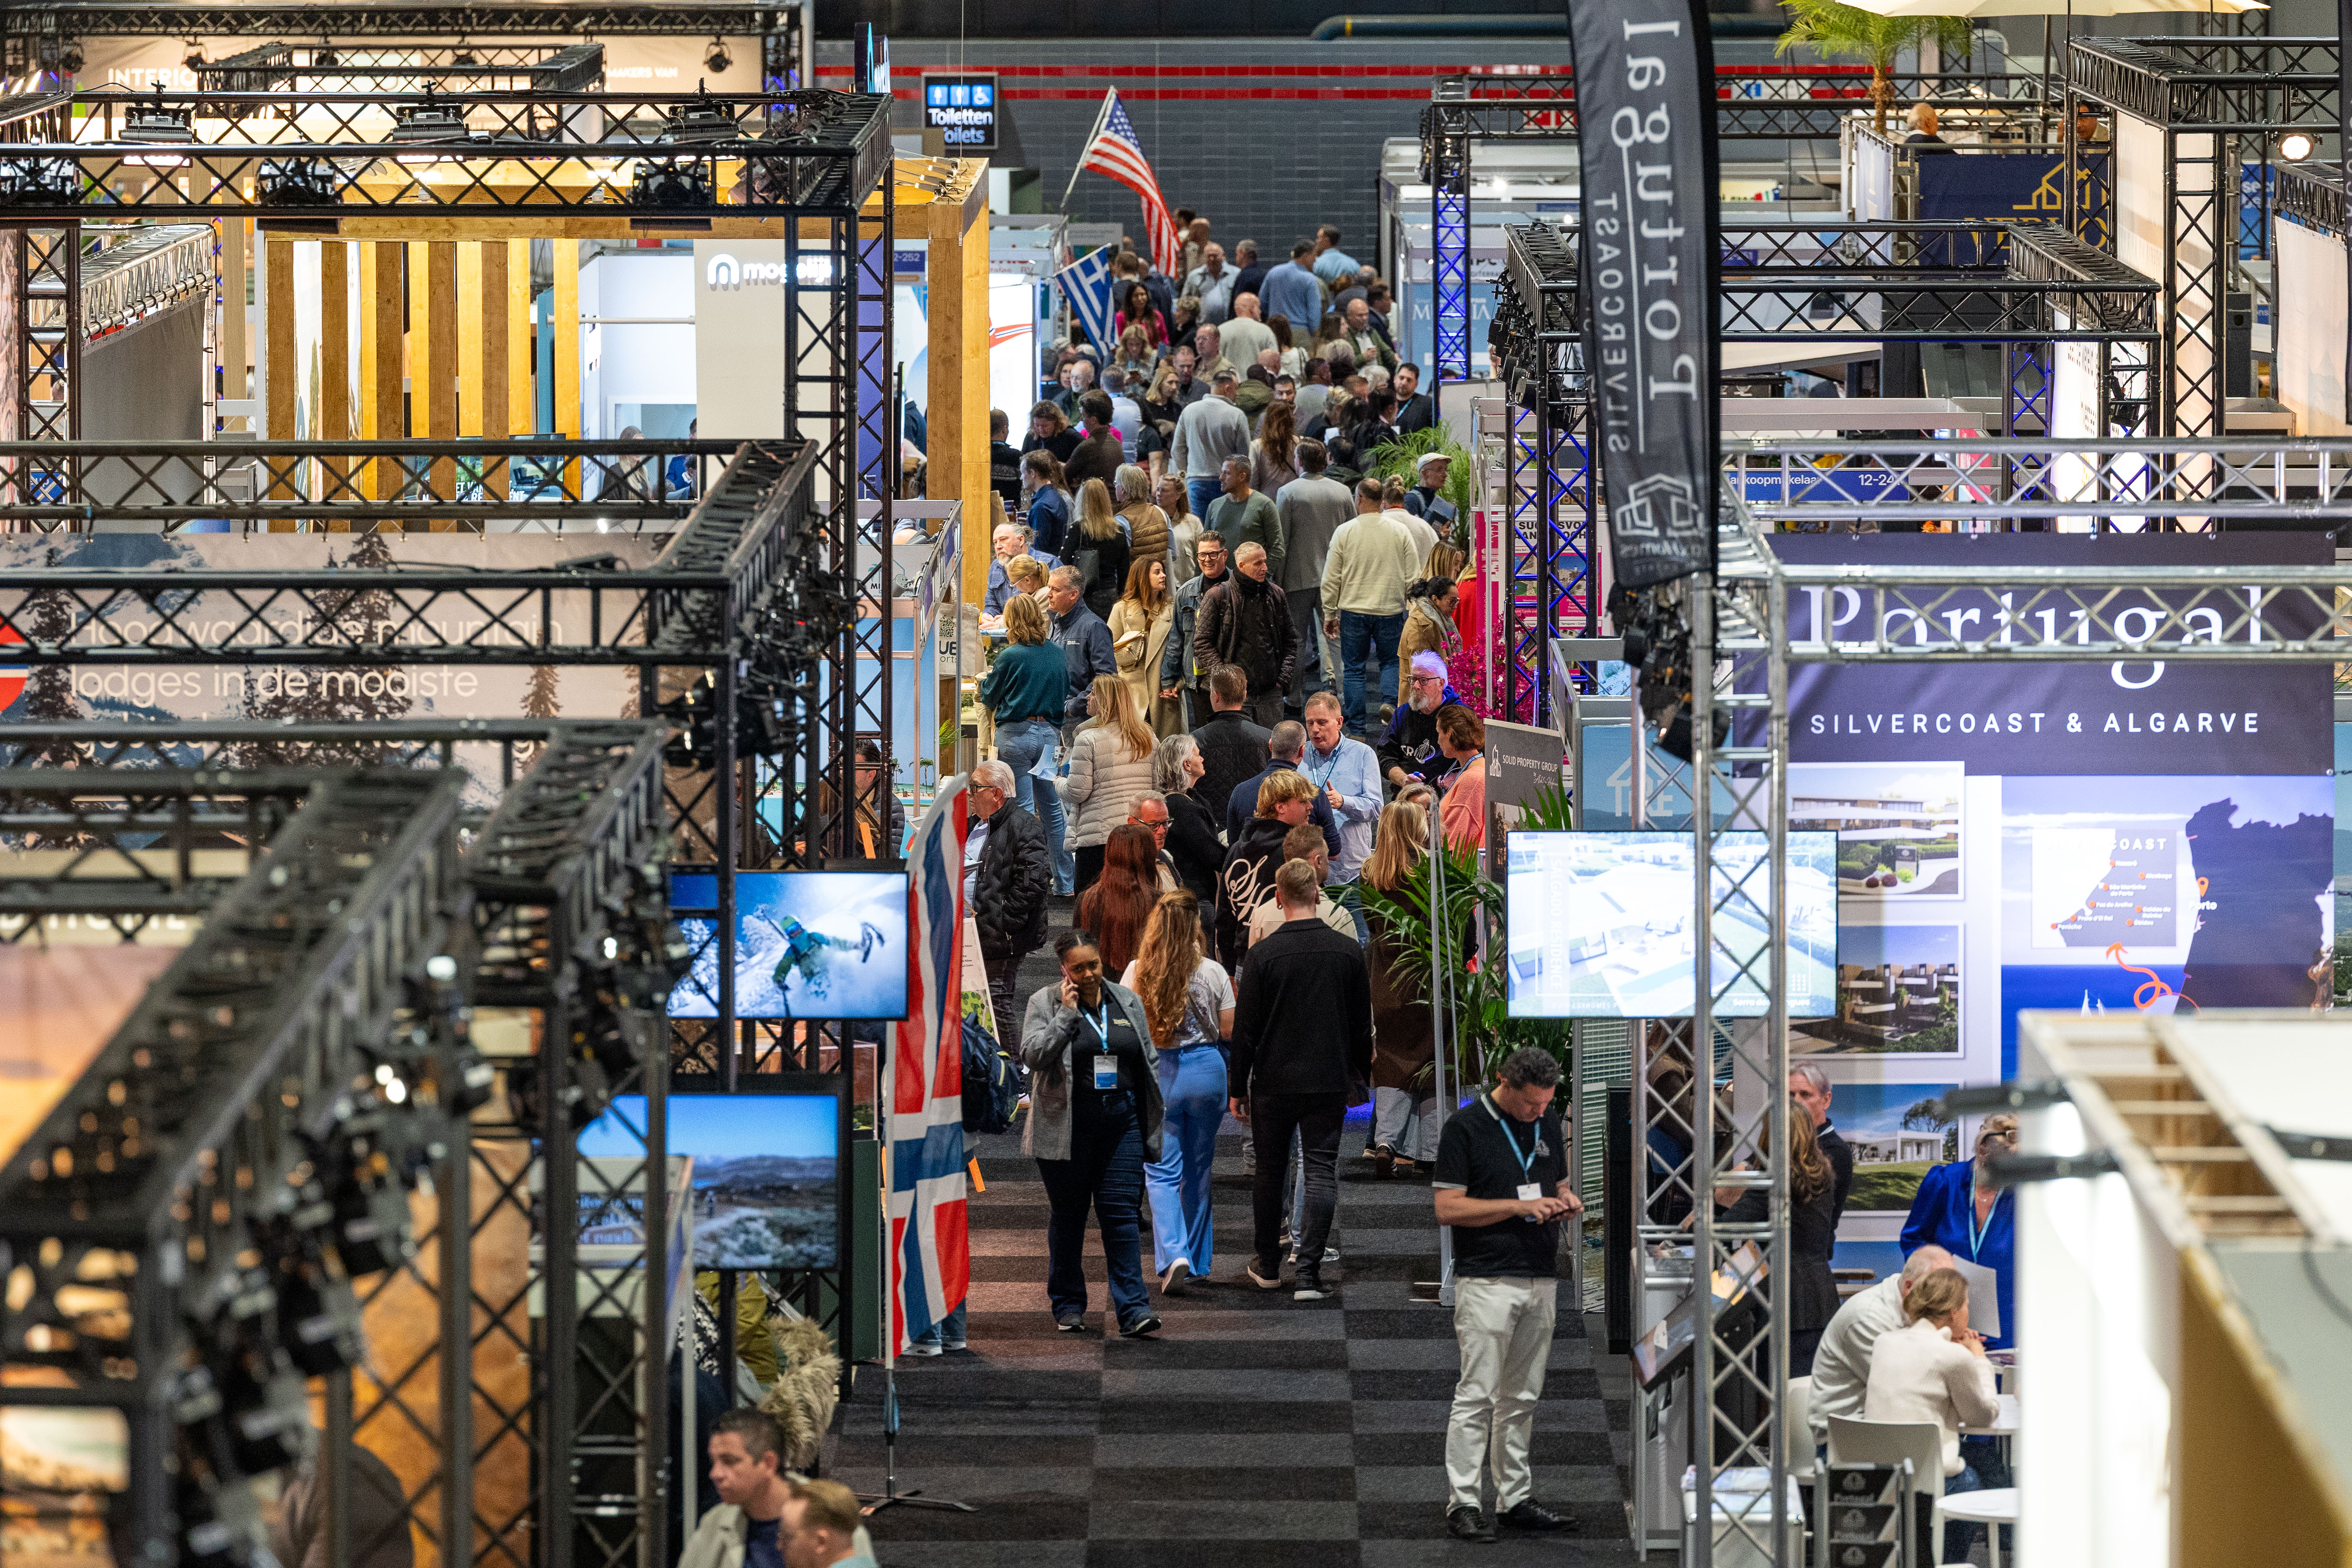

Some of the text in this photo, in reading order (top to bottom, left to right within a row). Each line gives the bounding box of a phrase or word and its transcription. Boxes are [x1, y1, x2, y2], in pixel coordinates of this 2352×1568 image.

[928, 107, 993, 125] Toiletten
[943, 127, 985, 143] oilets
[1731, 474, 1902, 487] akoopmkelaa 12-24
[1800, 585, 2262, 689] Portugal
[71, 665, 478, 707] lodges in de mooiste
[1810, 712, 2259, 734] SILVERCOAST & ALGARVE
[1503, 755, 1558, 772] SOLID PROPERTY GROUP
